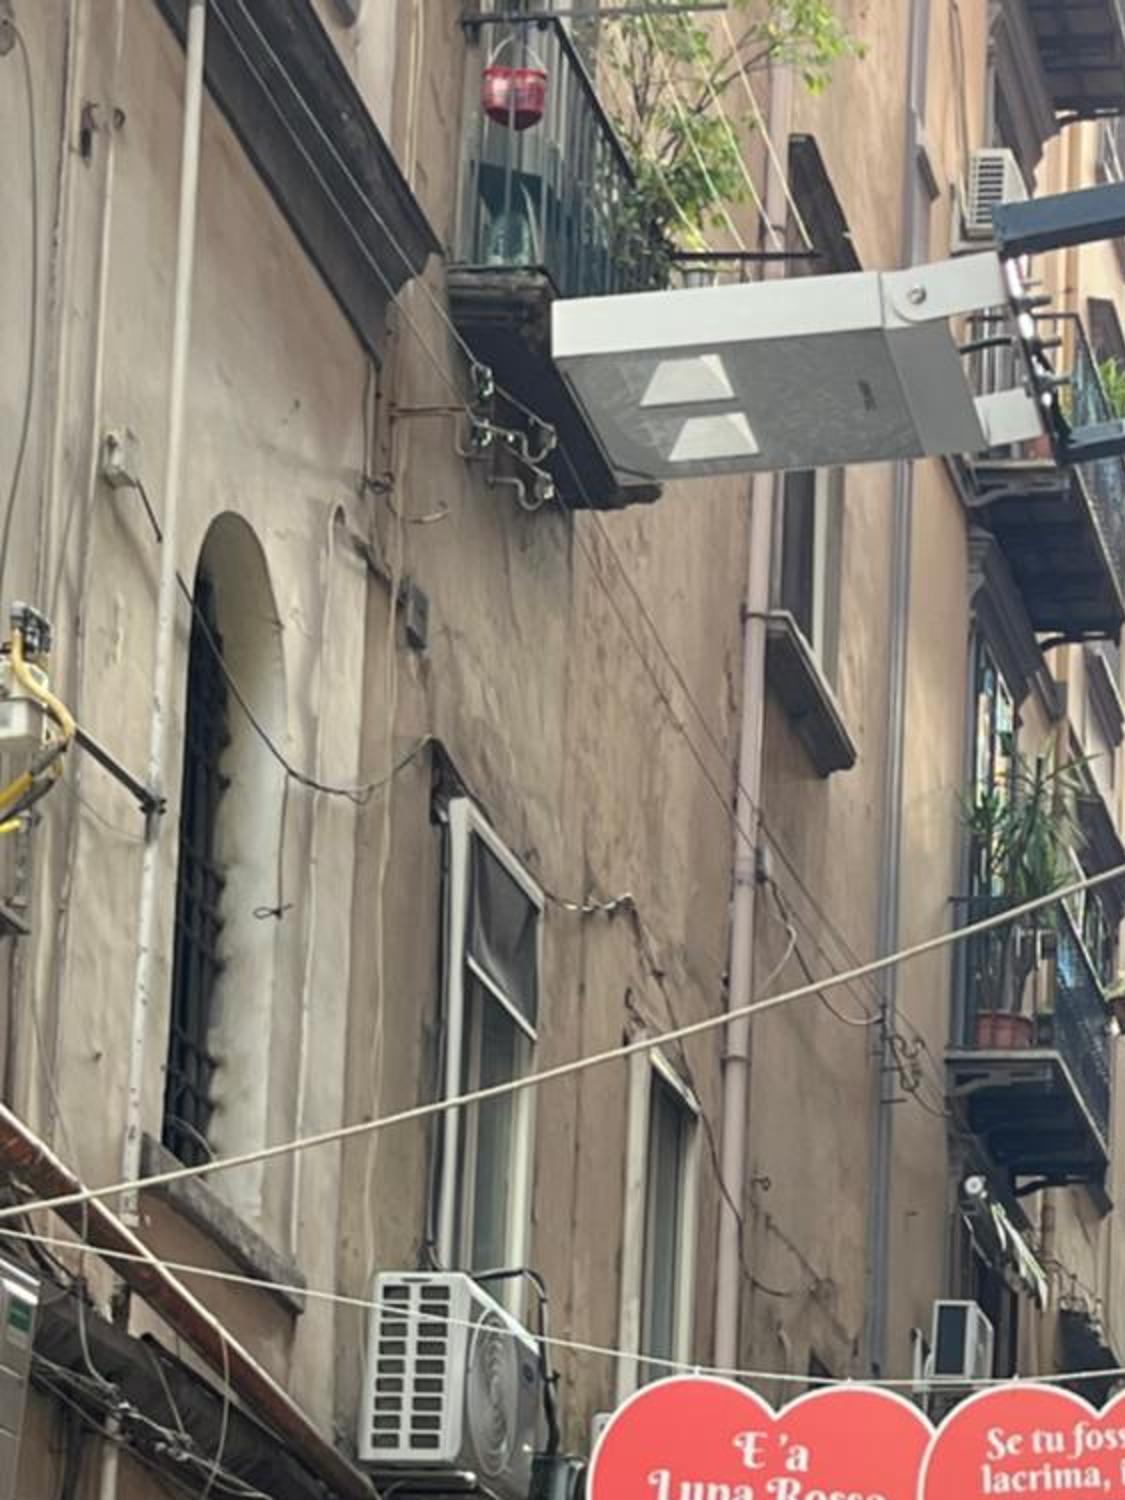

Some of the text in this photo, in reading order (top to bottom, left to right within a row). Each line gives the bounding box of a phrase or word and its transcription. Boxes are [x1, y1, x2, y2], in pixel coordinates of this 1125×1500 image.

[733, 1432, 767, 1469] E
[986, 1427, 1024, 1461] Se
[1031, 1428, 1065, 1453] tu
[981, 1463, 1112, 1494] lacrima,
